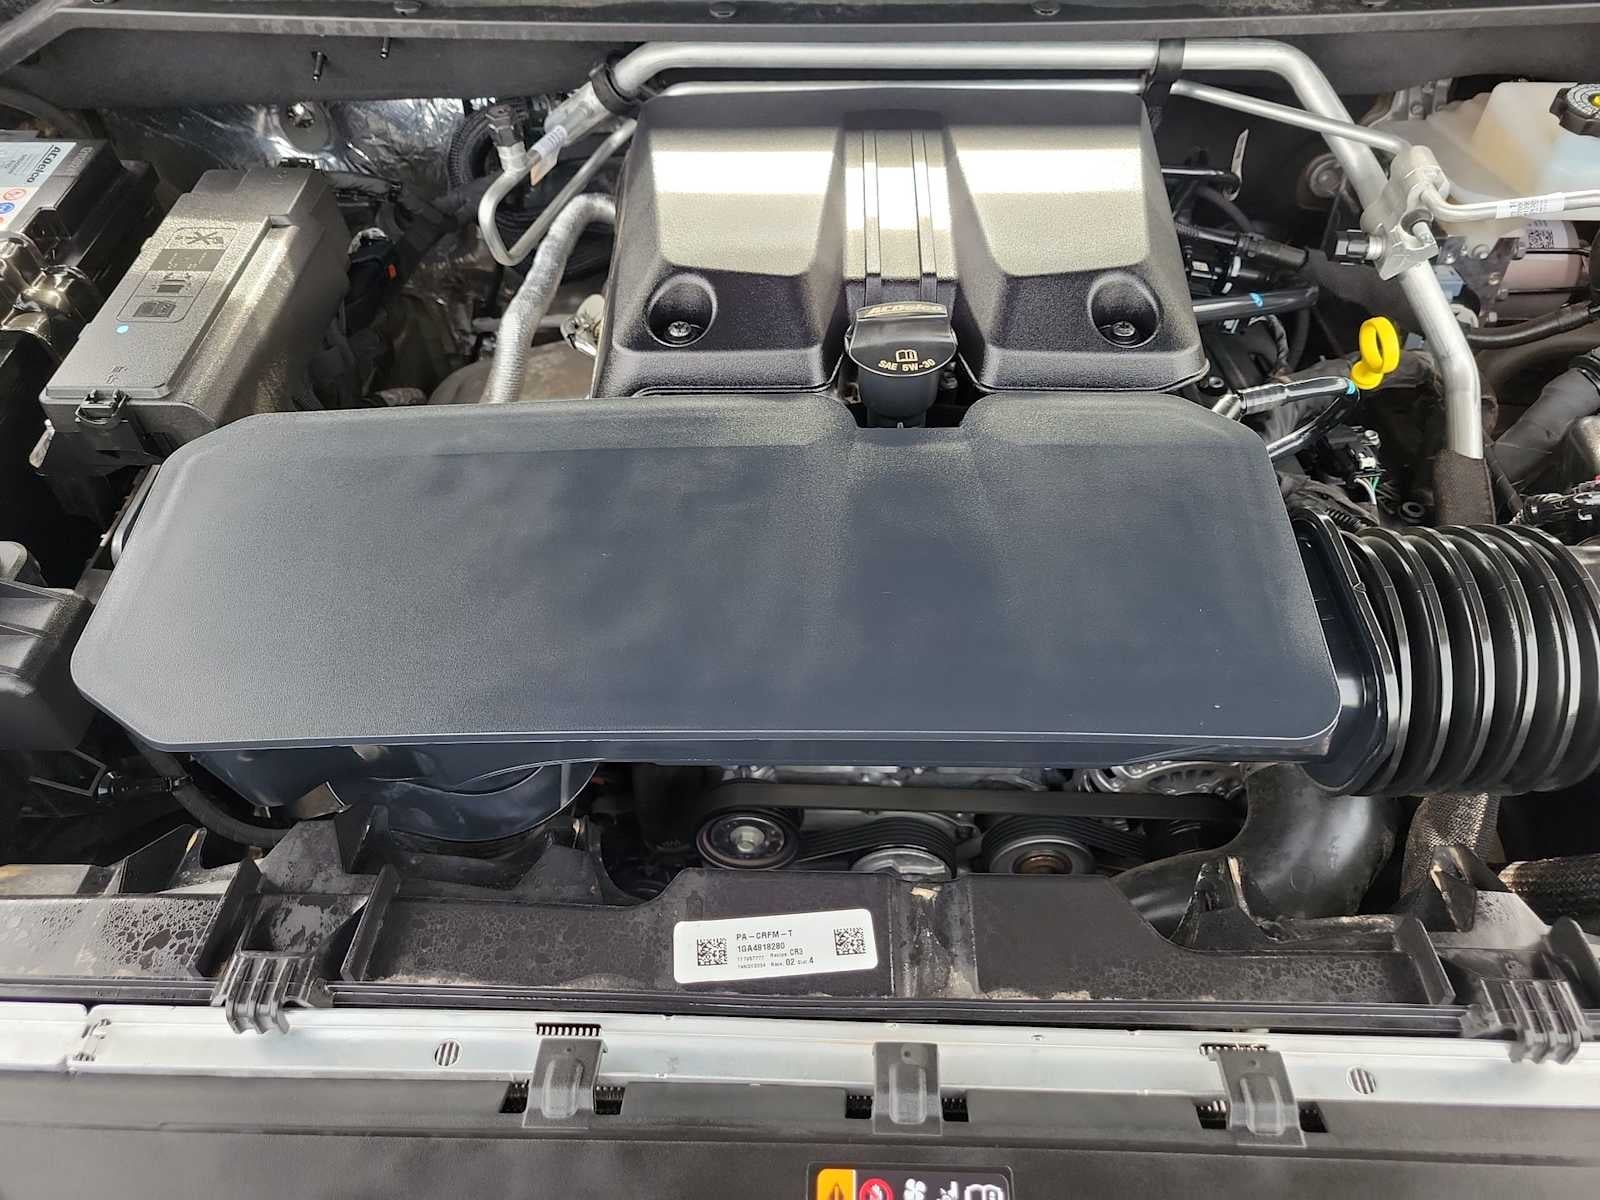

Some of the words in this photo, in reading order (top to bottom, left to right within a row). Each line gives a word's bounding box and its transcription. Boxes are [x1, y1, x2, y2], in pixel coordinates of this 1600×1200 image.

[878, 360, 898, 371] SAE
[901, 358, 937, 372] 5W-30
[785, 959, 795, 967] 02
